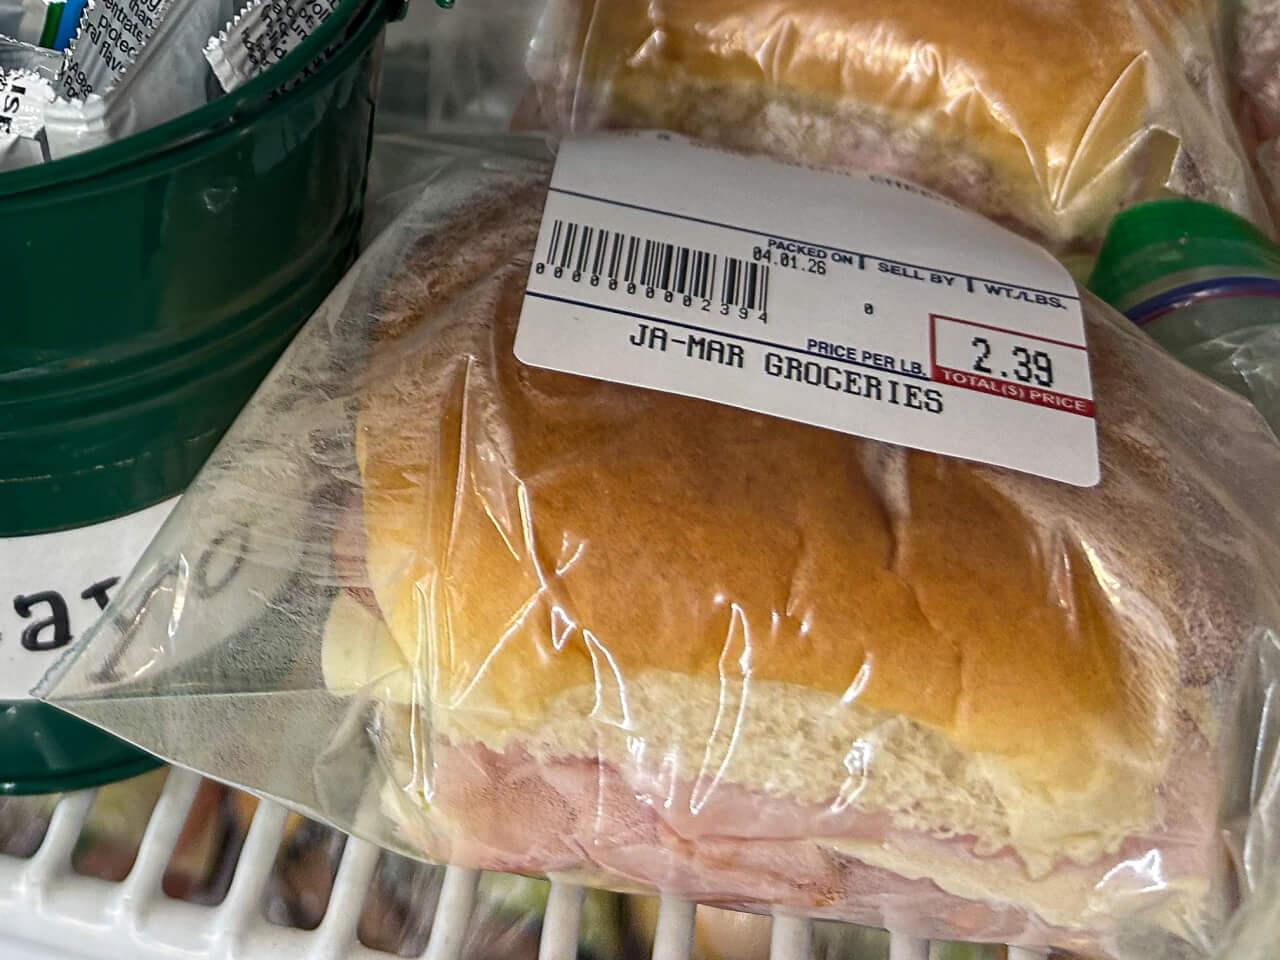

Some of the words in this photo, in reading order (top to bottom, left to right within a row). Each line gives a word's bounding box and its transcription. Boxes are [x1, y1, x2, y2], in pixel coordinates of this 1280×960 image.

[751, 245, 827, 276] 04.01.26
[767, 239, 827, 260] PACKED
[830, 249, 853, 266] ON
[877, 260, 924, 282] SELL
[929, 271, 955, 287] BY
[629, 323, 745, 369] JA-MAR
[764, 352, 945, 415] GROCERIES
[806, 338, 858, 363] PRICE
[861, 350, 896, 370] PER
[900, 358, 928, 378] LB.
[971, 337, 1055, 389] 2.39
[939, 366, 1026, 400] TOTAL($)
[1028, 390, 1088, 413] PRICE
